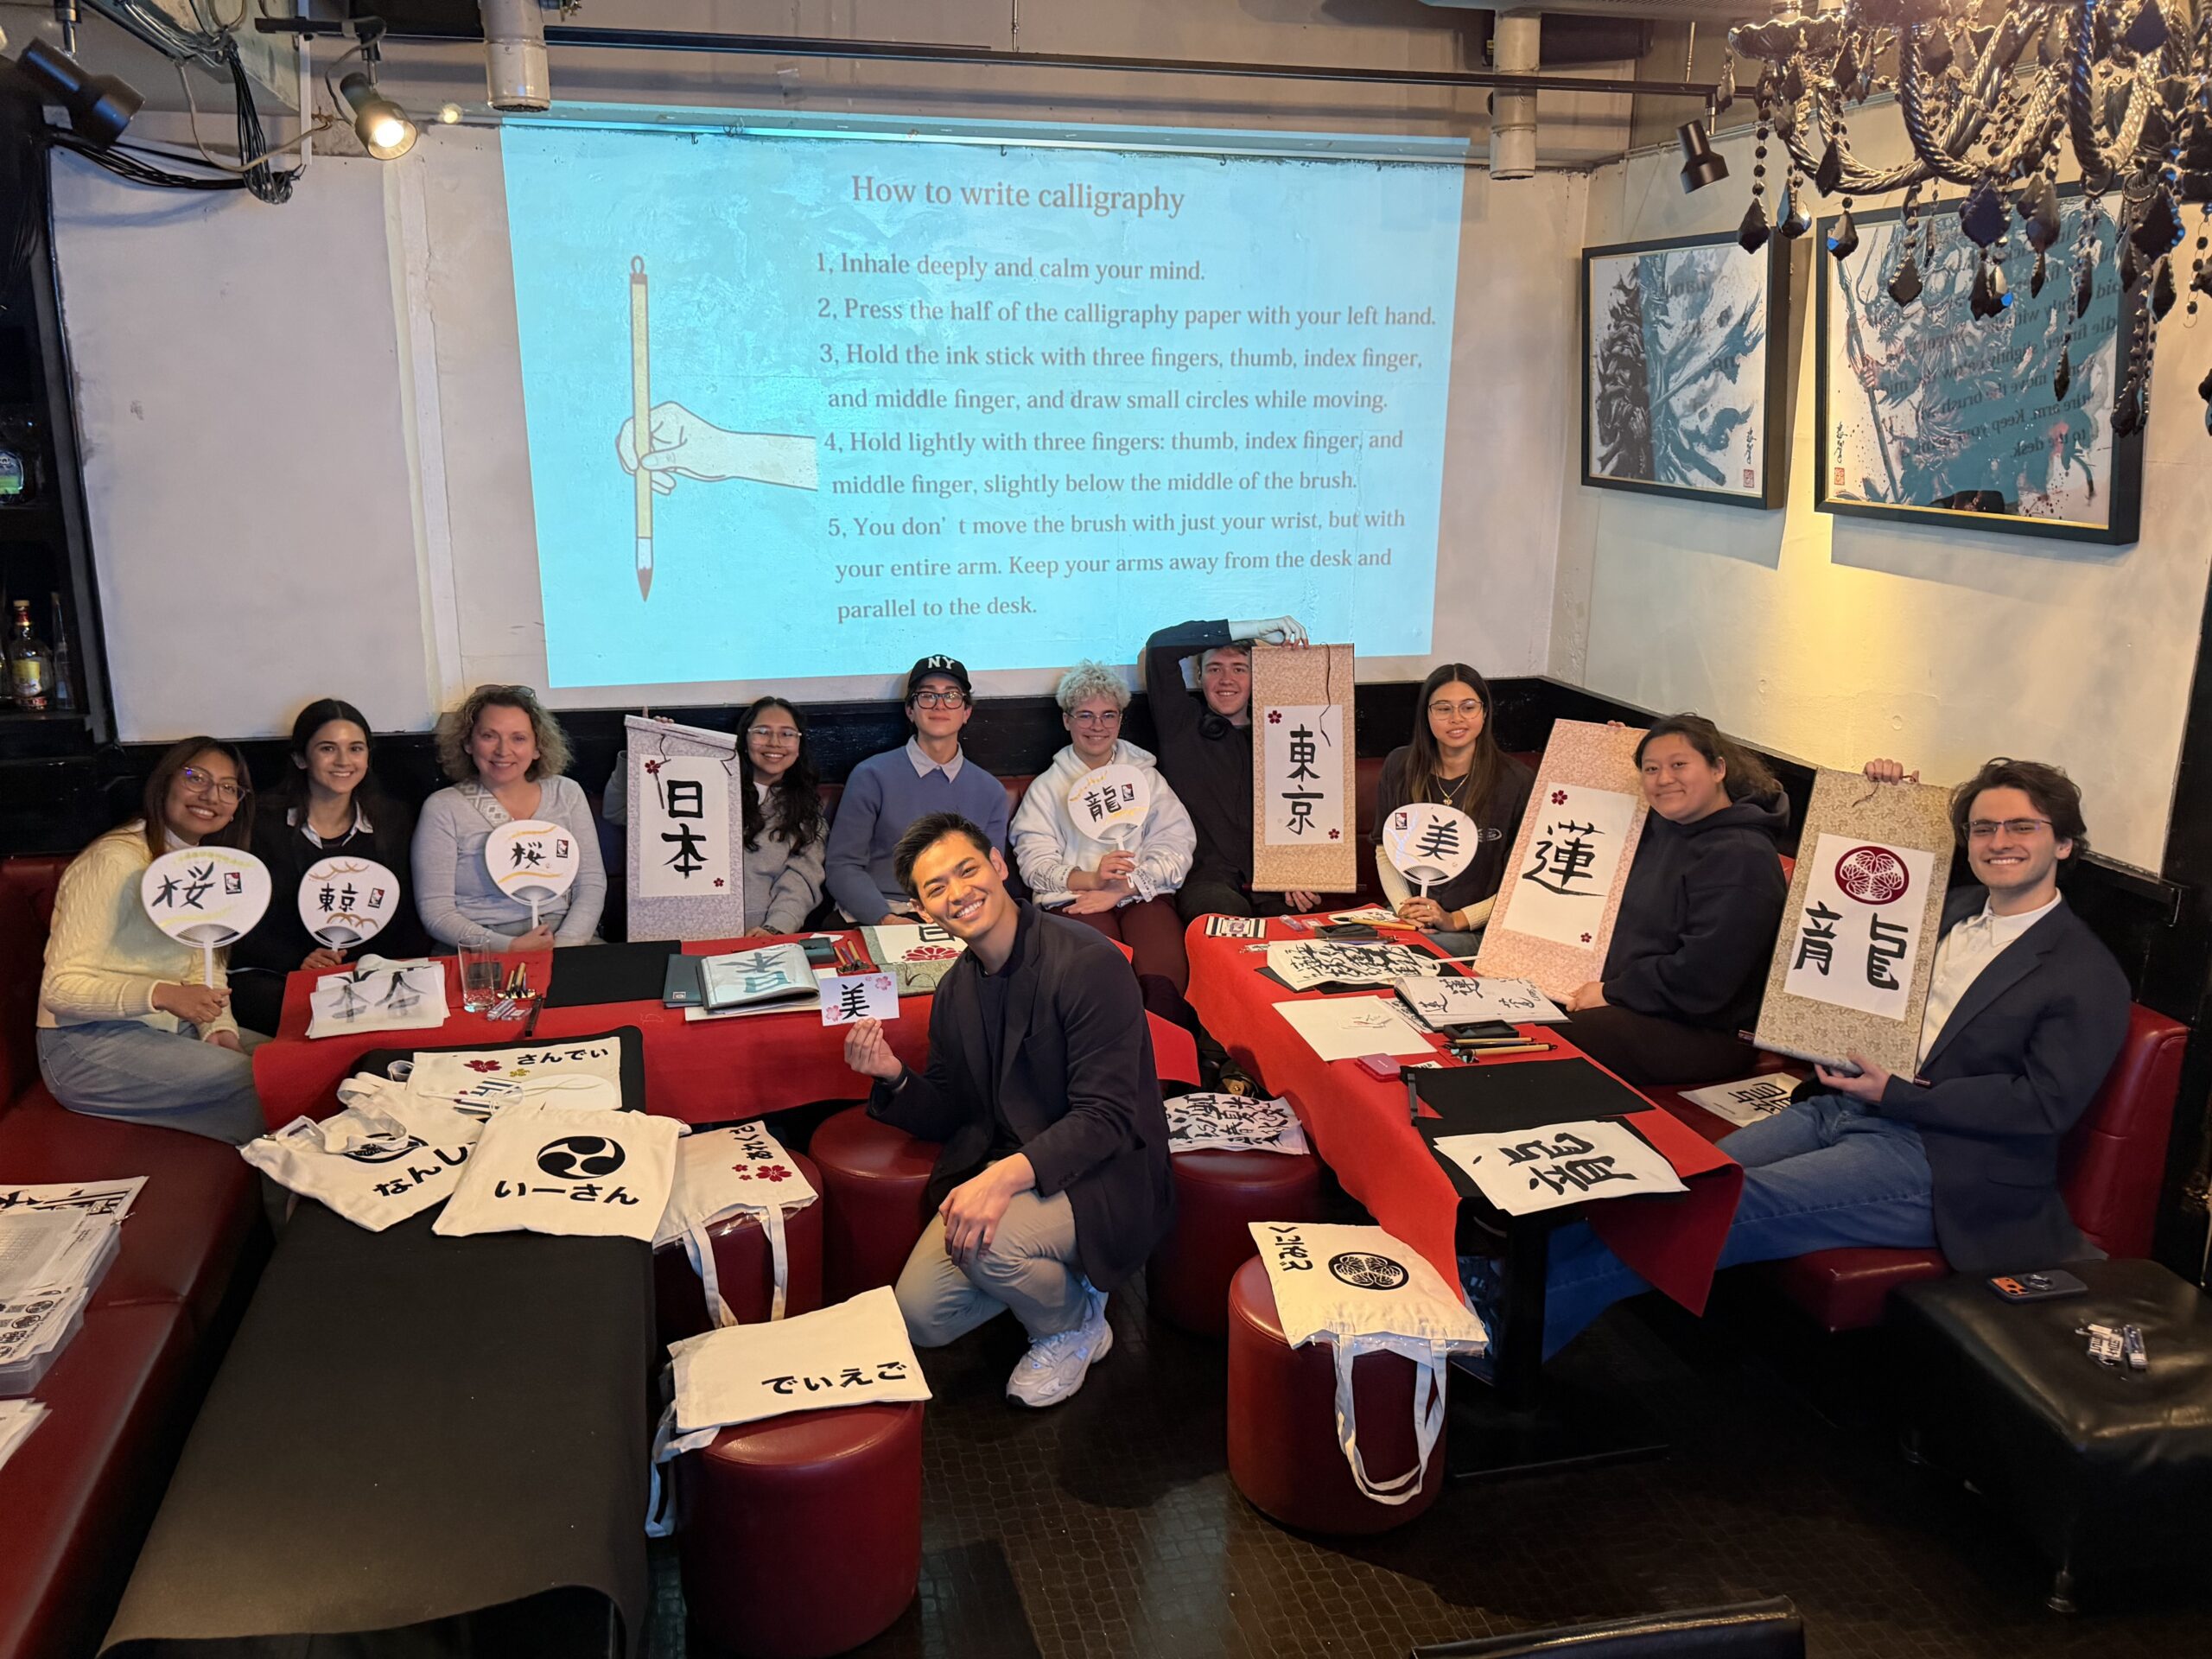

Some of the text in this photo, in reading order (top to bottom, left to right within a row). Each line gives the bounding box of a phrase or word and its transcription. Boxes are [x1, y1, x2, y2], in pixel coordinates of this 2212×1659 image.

[852, 175, 1185, 219] How to write calligraphy
[842, 253, 910, 274] Inhale
[917, 255, 988, 282] deeply
[995, 257, 1033, 276] and
[1039, 258, 1089, 277] calm
[1095, 264, 1143, 284] your
[1150, 260, 1205, 280] mind.
[845, 298, 902, 319] Press
[911, 300, 943, 320] the
[951, 301, 993, 321] half
[998, 301, 1020, 321] of
[1026, 302, 1058, 321] the
[1065, 303, 1179, 329] calligraphy
[1185, 310, 1242, 329] paper
[1248, 305, 1290, 324] with
[1295, 311, 1341, 330] your
[1348, 306, 1377, 325] left
[1385, 306, 1435, 325] hand.
[847, 344, 899, 364] Hold
[906, 345, 938, 364] the
[947, 346, 979, 365] ink
[986, 346, 1034, 365] stick
[1041, 346, 1085, 365] with
[1093, 346, 1144, 366] three
[1152, 347, 1223, 372] fingers,
[1230, 347, 1296, 368] thumb,
[1305, 348, 1356, 366] index
[1363, 347, 1421, 372] finger,
[829, 388, 1387, 414] and middle finger, and draw small circles while moving.
[850, 432, 901, 451] Hold
[909, 432, 976, 456] lightly
[982, 432, 1027, 451] with
[1034, 432, 1085, 450] three
[1092, 432, 1164, 456] fingers:
[1172, 431, 1237, 451] thumb,
[1245, 431, 1297, 449] index
[1303, 430, 1363, 454] finger,
[1369, 430, 1402, 448] and
[832, 471, 1357, 499] middle finger, slightly below the middle of the brush.
[853, 518, 895, 536] You
[973, 521, 1027, 534] move
[1034, 515, 1065, 533] the
[1071, 514, 1126, 532] brush
[1133, 513, 1174, 531] with
[1178, 513, 1215, 536] just
[1221, 517, 1265, 535] your
[1271, 512, 1321, 530] wrist,
[1329, 511, 1358, 528] but
[1364, 509, 1404, 527] with
[836, 549, 1391, 583] your entire arm. Keep your arms away from the desk and
[838, 596, 1036, 623] parallel to the desk.
[927, 655, 955, 670] NY
[1281, 723, 1325, 836] 東京
[1084, 785, 1122, 823] 龍
[661, 779, 709, 879] 日本
[1415, 814, 1460, 861] 美
[510, 841, 547, 869] 桜
[1522, 819, 1607, 897] 蓮
[151, 861, 217, 911] 桜
[318, 882, 359, 912] 東京
[839, 982, 871, 1020] 美
[372, 1133, 476, 1197] なんし
[494, 1179, 640, 1206] いーさん
